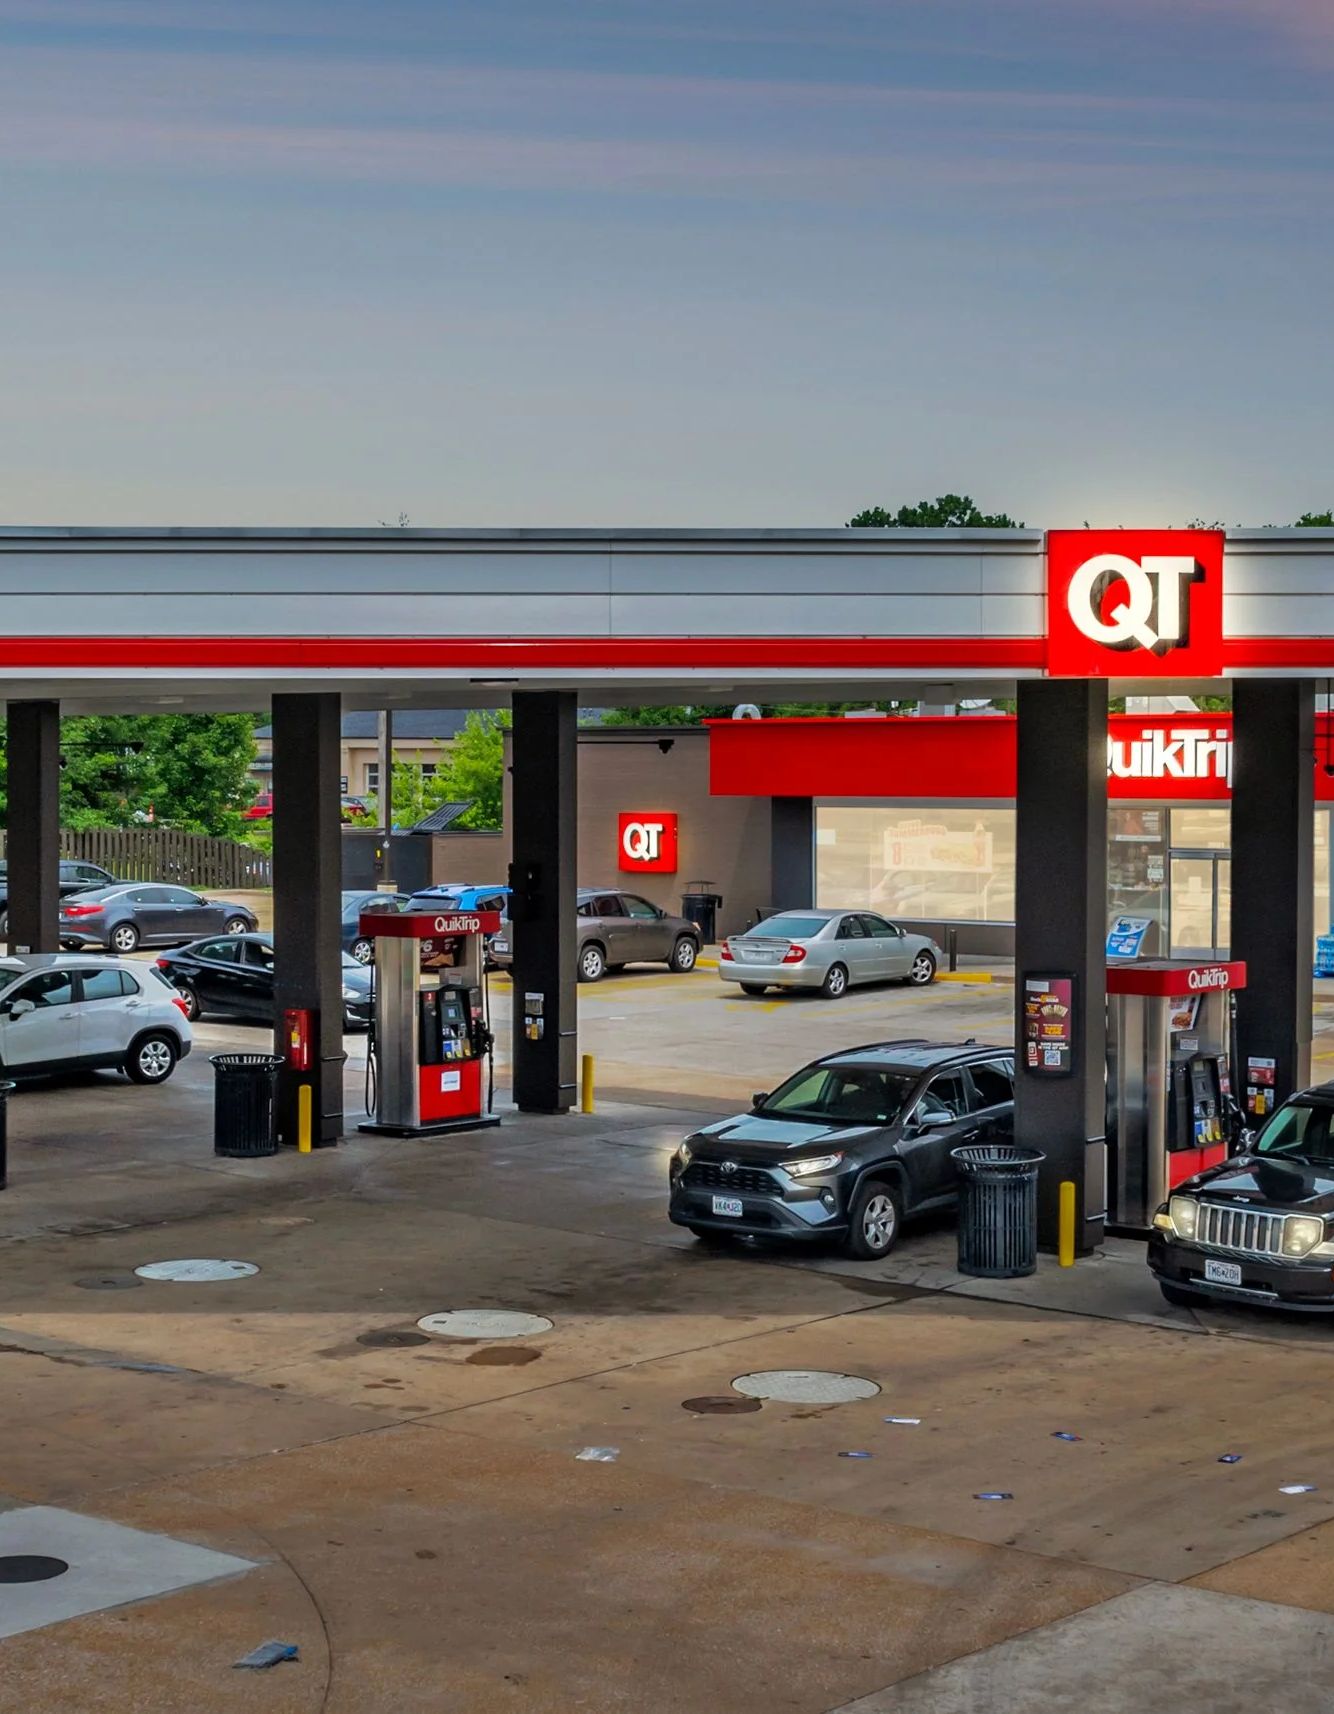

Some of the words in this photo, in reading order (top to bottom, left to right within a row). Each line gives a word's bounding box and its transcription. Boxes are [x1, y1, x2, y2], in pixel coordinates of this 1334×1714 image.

[1068, 554, 1196, 650] QT
[1107, 729, 1233, 788] uikTri
[623, 822, 663, 861] QT
[434, 916, 480, 933] QuikTrip
[1188, 968, 1229, 989] QuikTrip
